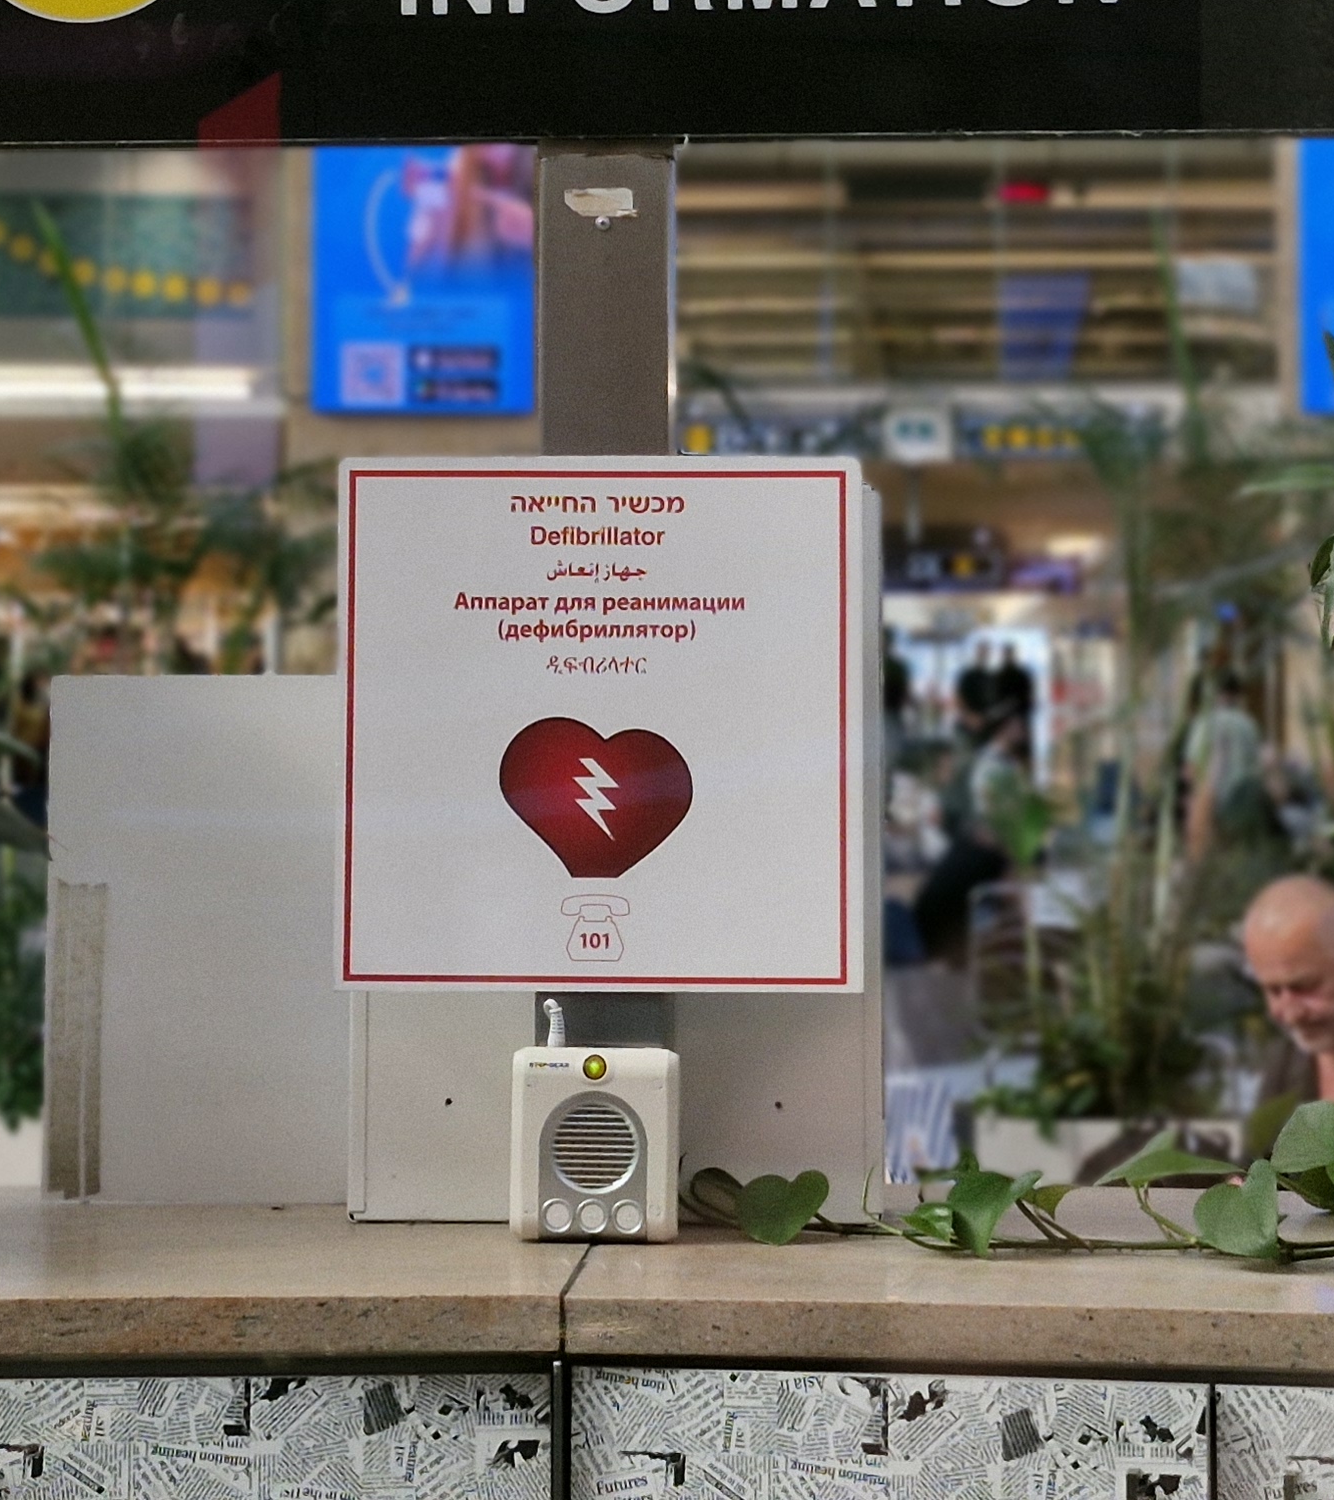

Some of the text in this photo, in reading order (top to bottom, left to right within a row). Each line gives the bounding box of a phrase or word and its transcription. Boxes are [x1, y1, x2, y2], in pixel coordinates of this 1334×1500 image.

[511, 496, 684, 513] מכשיר החייאה
[531, 526, 665, 545] Defibrillator
[604, 563, 646, 581] جهاز
[454, 592, 744, 615] Аппарат для реанимации
[499, 619, 695, 642] (дефибриллятор)
[580, 933, 609, 949] 101
[596, 1474, 648, 1496] Futures
